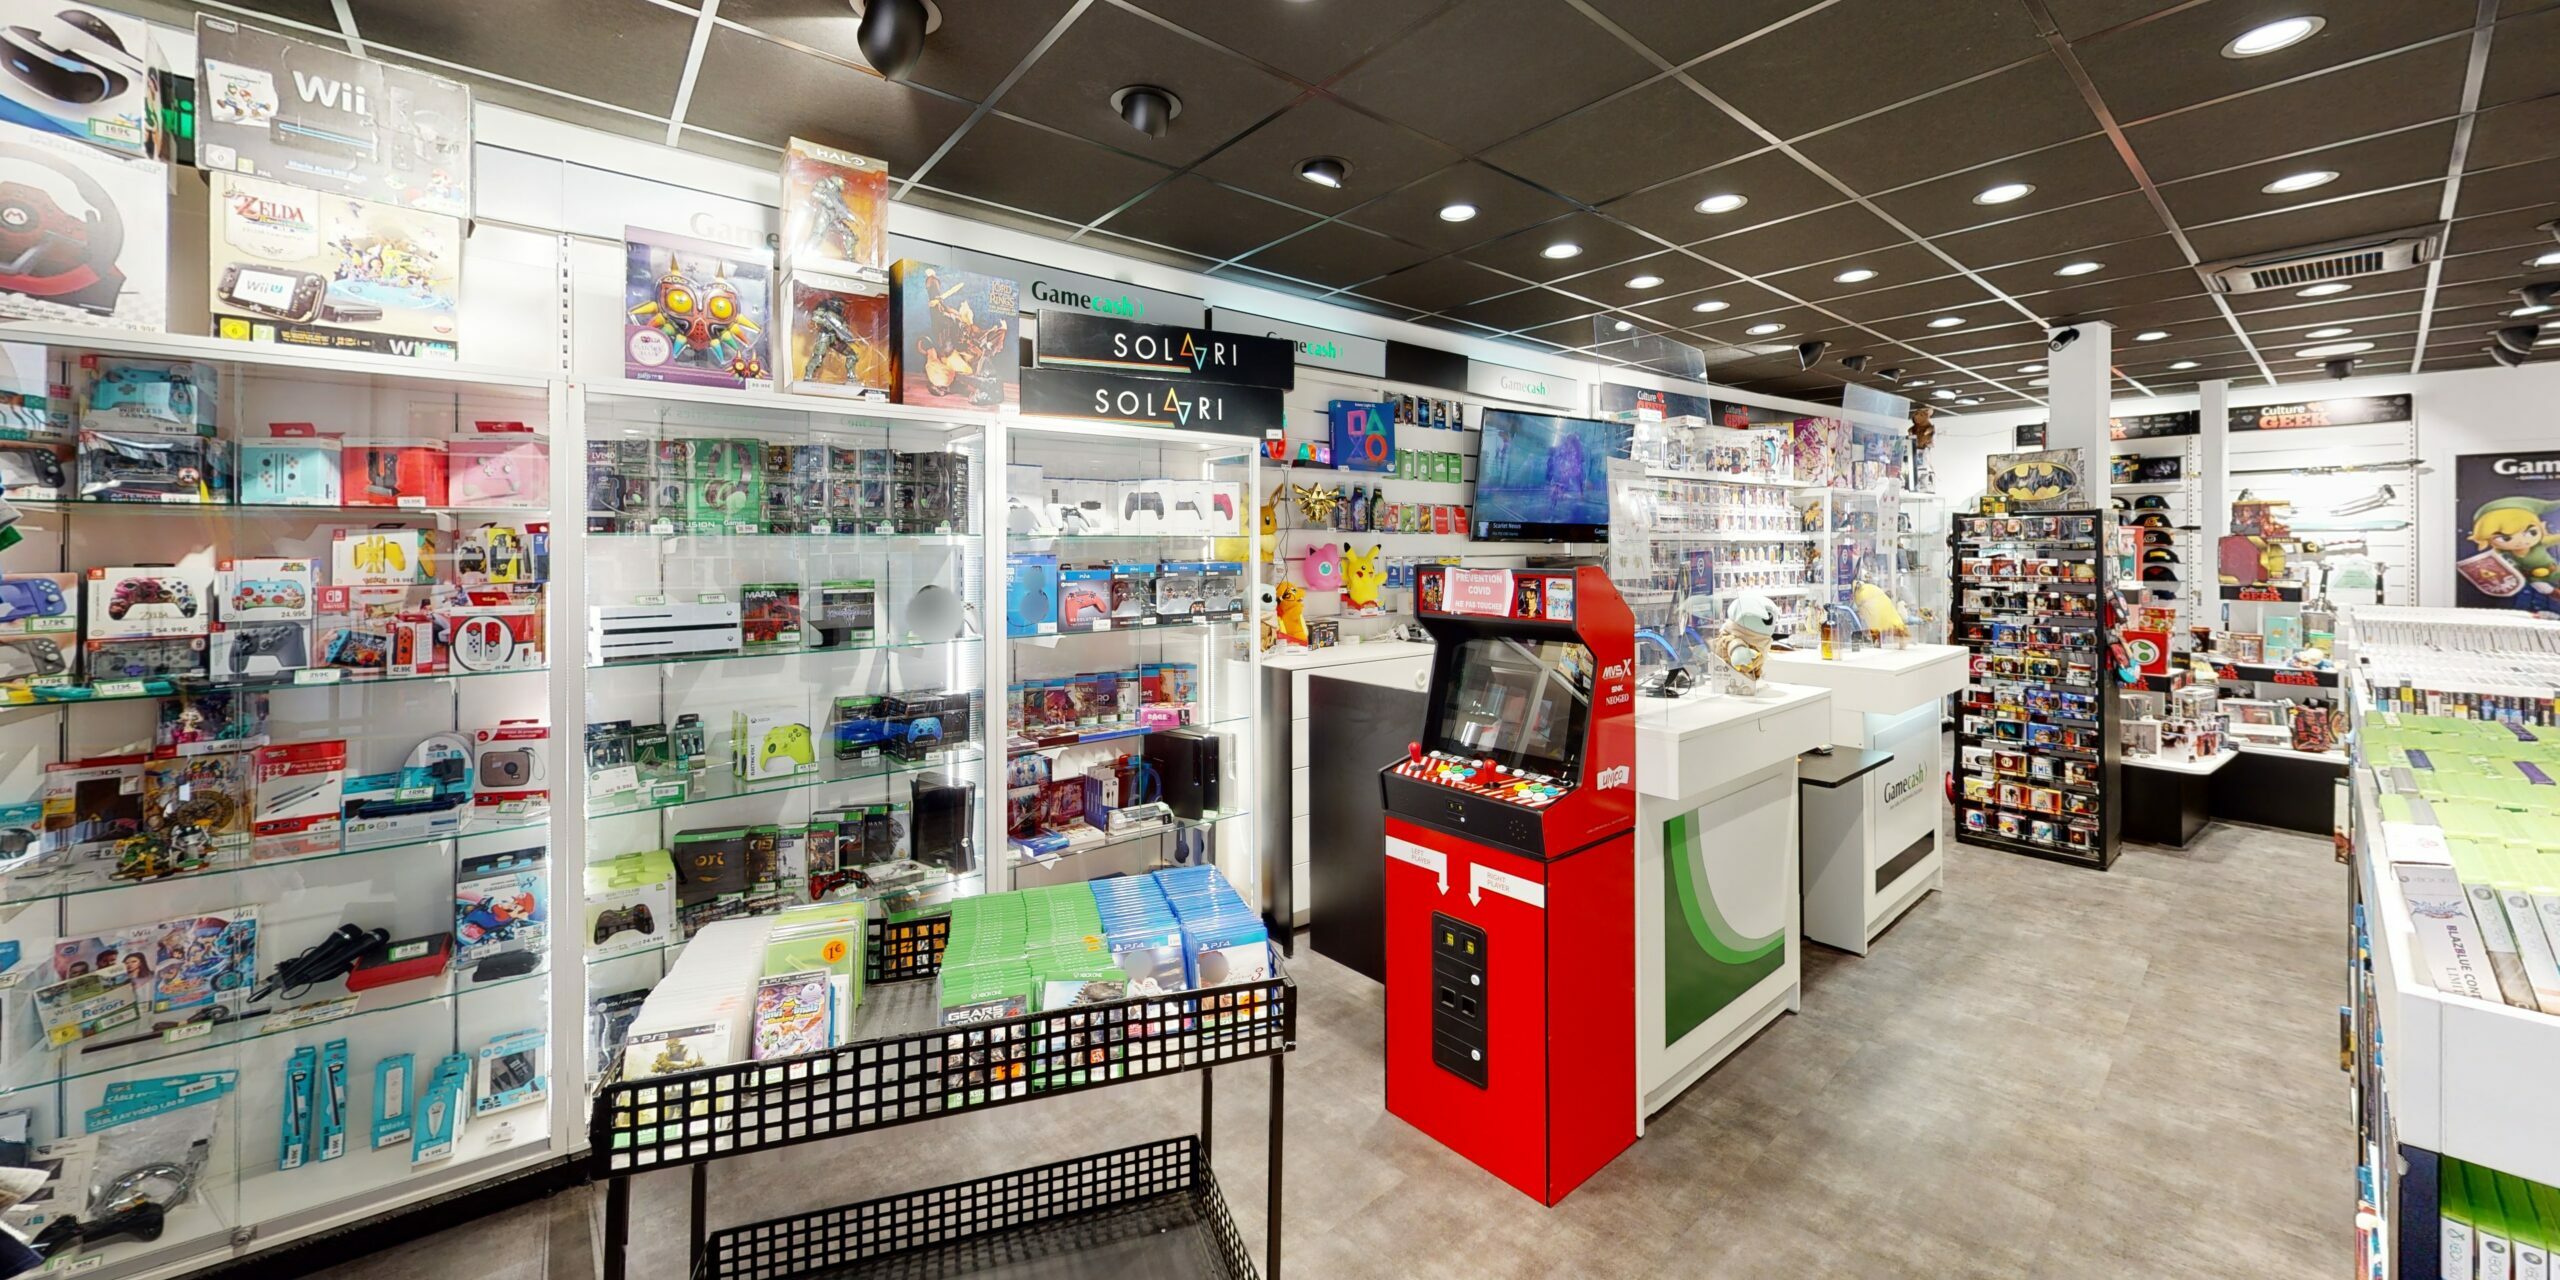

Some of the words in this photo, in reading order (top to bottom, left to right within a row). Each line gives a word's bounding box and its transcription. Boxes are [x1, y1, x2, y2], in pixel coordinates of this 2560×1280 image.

[293, 70, 369, 115] Wii
[816, 147, 867, 167] HALO
[234, 194, 305, 223] ZELDA
[817, 276, 867, 292] HALO
[1031, 280, 1135, 318] Gamecash
[1500, 375, 1547, 396] Gamecash
[2260, 404, 2306, 416] Culture
[2258, 412, 2330, 430] GEEK
[723, 519, 746, 527] Games
[745, 590, 777, 599] MAFIA
[1468, 585, 1491, 596] COVID
[2238, 591, 2282, 601] GEEK
[1611, 684, 1624, 693] SNK
[2273, 675, 2320, 687] GEEK
[1602, 768, 1624, 786] UNICO
[1883, 762, 1926, 804] Gamecash
[1411, 854, 1431, 866] PLAYER
[1486, 871, 1506, 883] RIGHT
[1486, 878, 1510, 893] PLAYER
[827, 943, 842, 960] 1€
[1123, 942, 1145, 950] PS4
[1210, 940, 1232, 949] PS4
[2445, 924, 2473, 972] BLAZBLUE
[81, 999, 125, 1019] Resort
[947, 1005, 1004, 1022] GEARS
[641, 1032, 669, 1043] PS3
